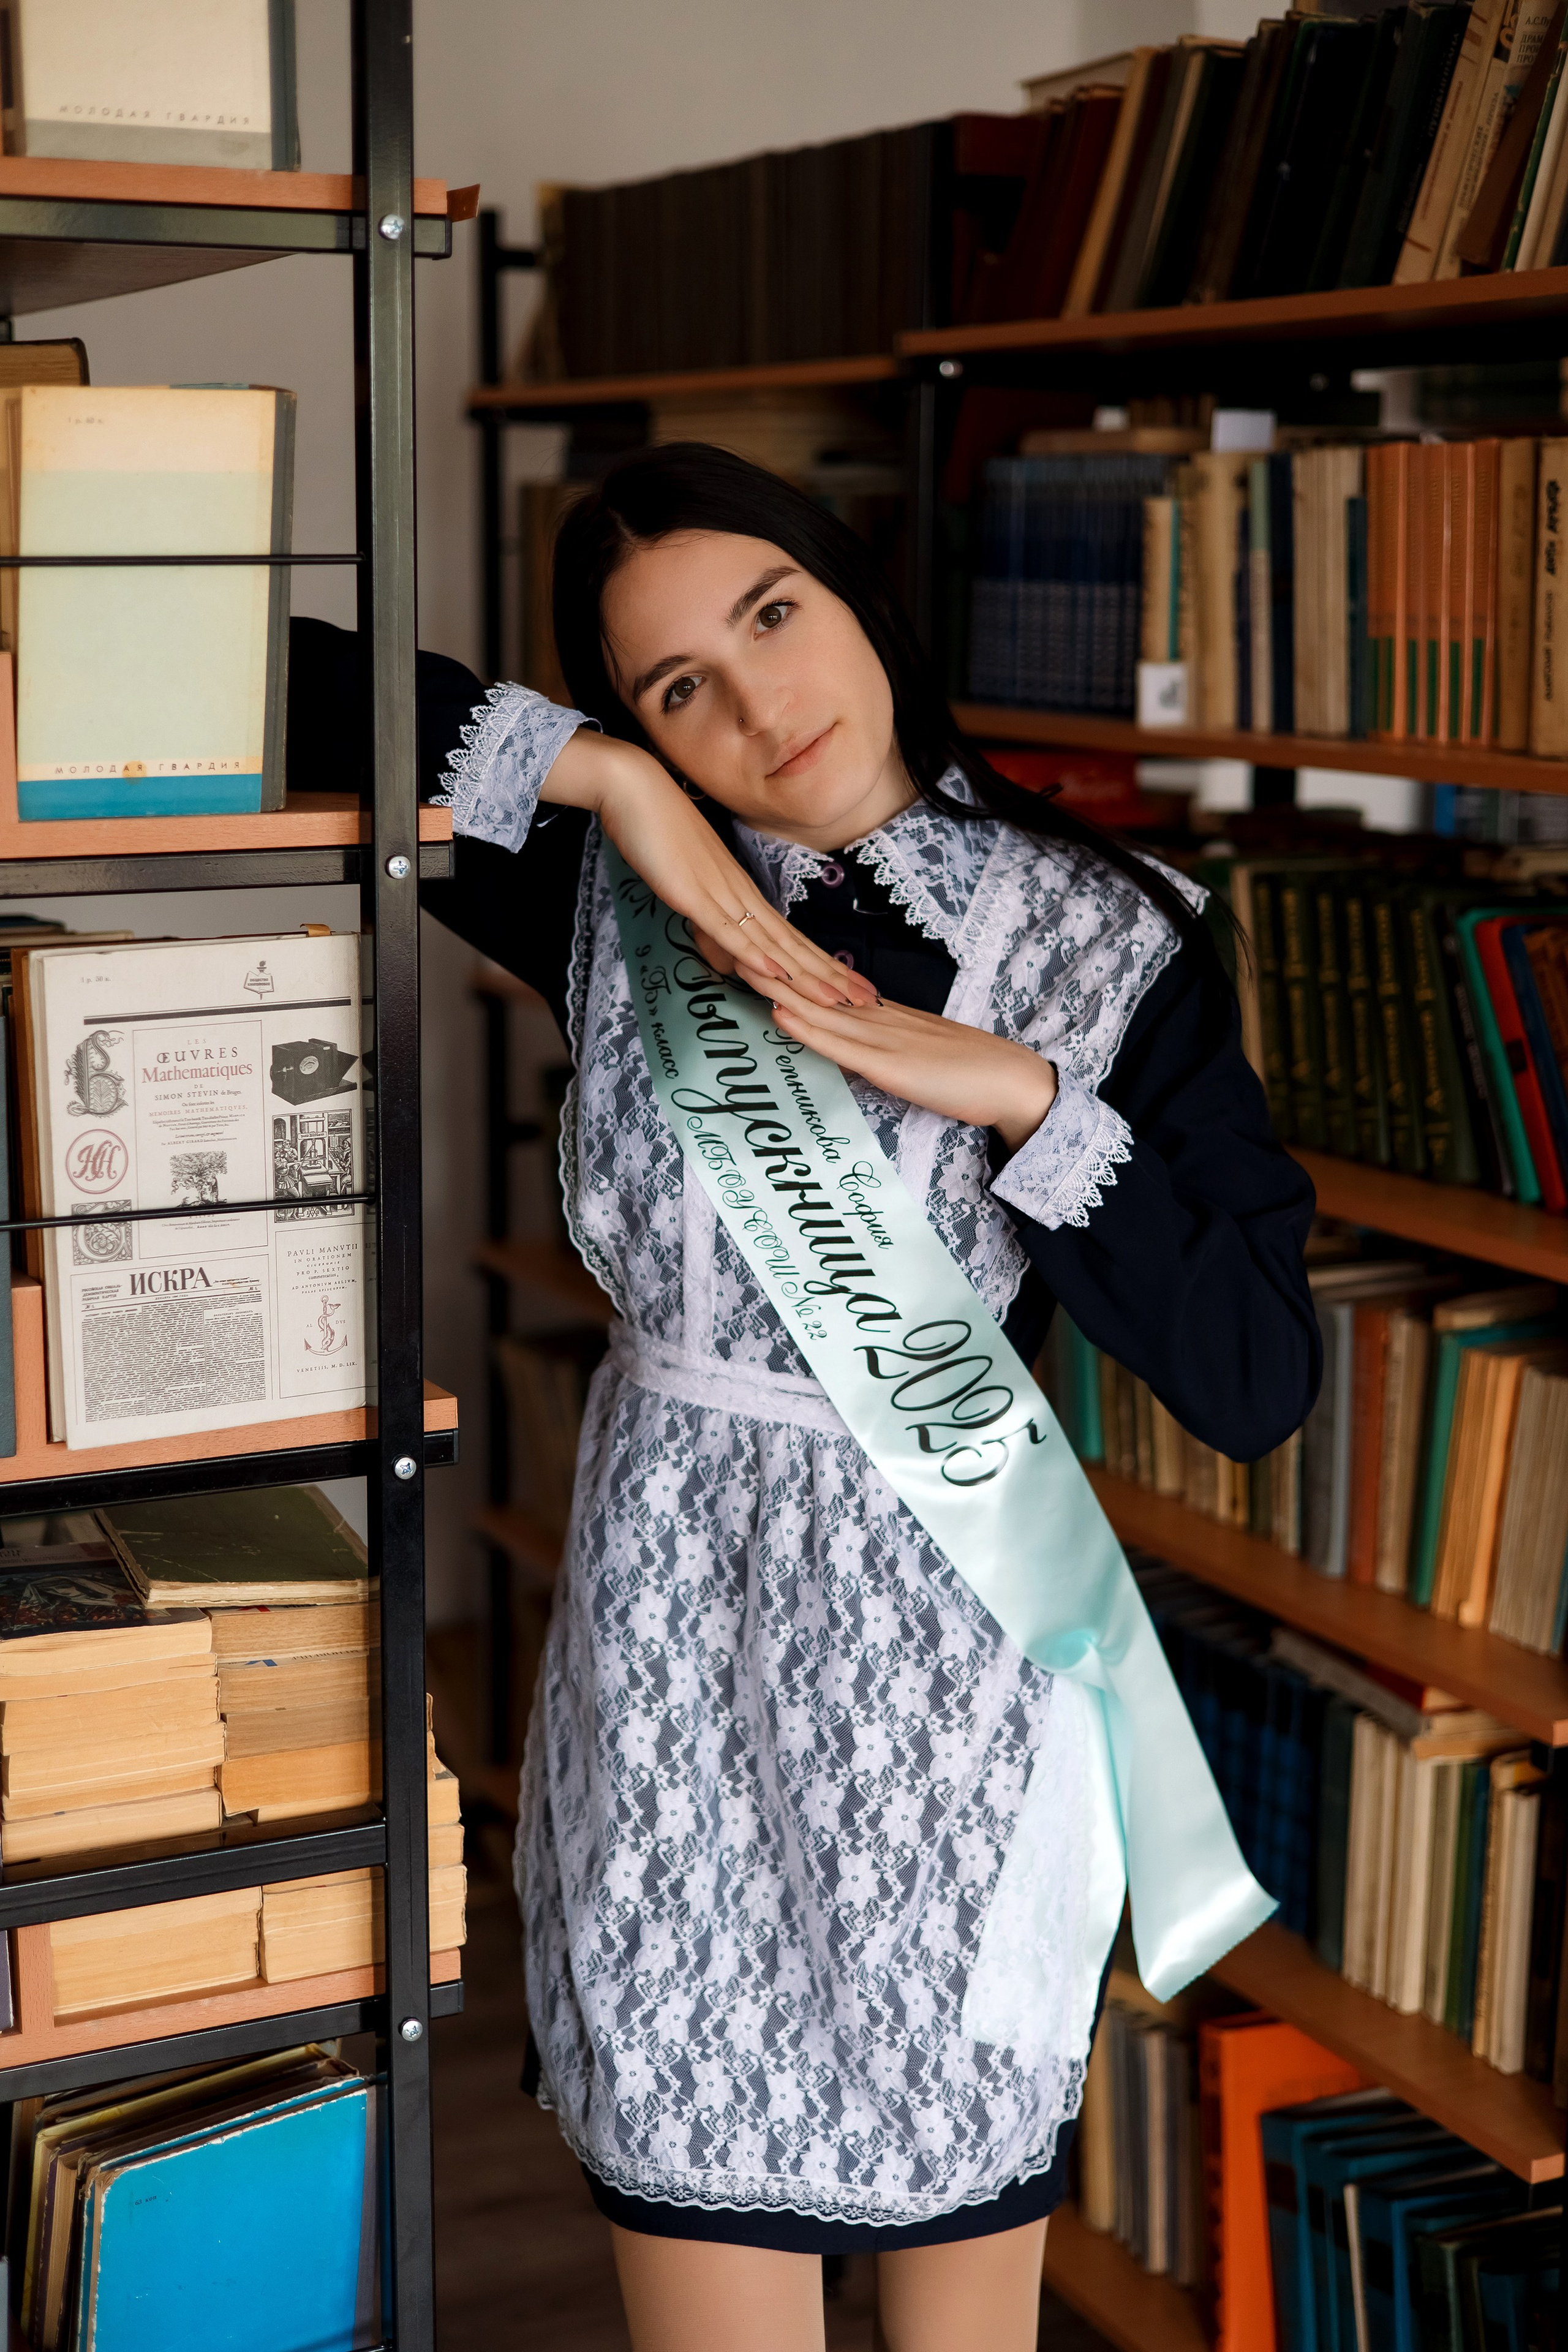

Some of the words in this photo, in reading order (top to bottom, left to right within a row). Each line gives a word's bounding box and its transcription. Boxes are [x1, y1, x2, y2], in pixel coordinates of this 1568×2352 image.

[58, 105, 152, 120] МОЛОДАЯ
[165, 112, 251, 125] ГВАРДИЯ
[55, 764, 143, 774] МОЛОДАЯ
[159, 761, 241, 772] ГВАРДИЯ
[635, 944, 652, 957] 9
[651, 1022, 679, 1080] класс
[141, 1062, 253, 1084] Mathematiques
[187, 1090, 219, 1098] STEVIN
[763, 1027, 850, 1164] Репникова
[837, 1161, 894, 1250] София
[665, 911, 903, 1333] Выпускница
[853, 1319, 1047, 1487] 2025
[306, 1253, 352, 1262] ORATIONEM
[319, 1243, 358, 1253] MANVTII
[129, 1267, 213, 1295] ИСКРА
[742, 1208, 800, 1279] СОШ
[781, 1282, 821, 1319] №
[801, 1320, 827, 1340] 22
